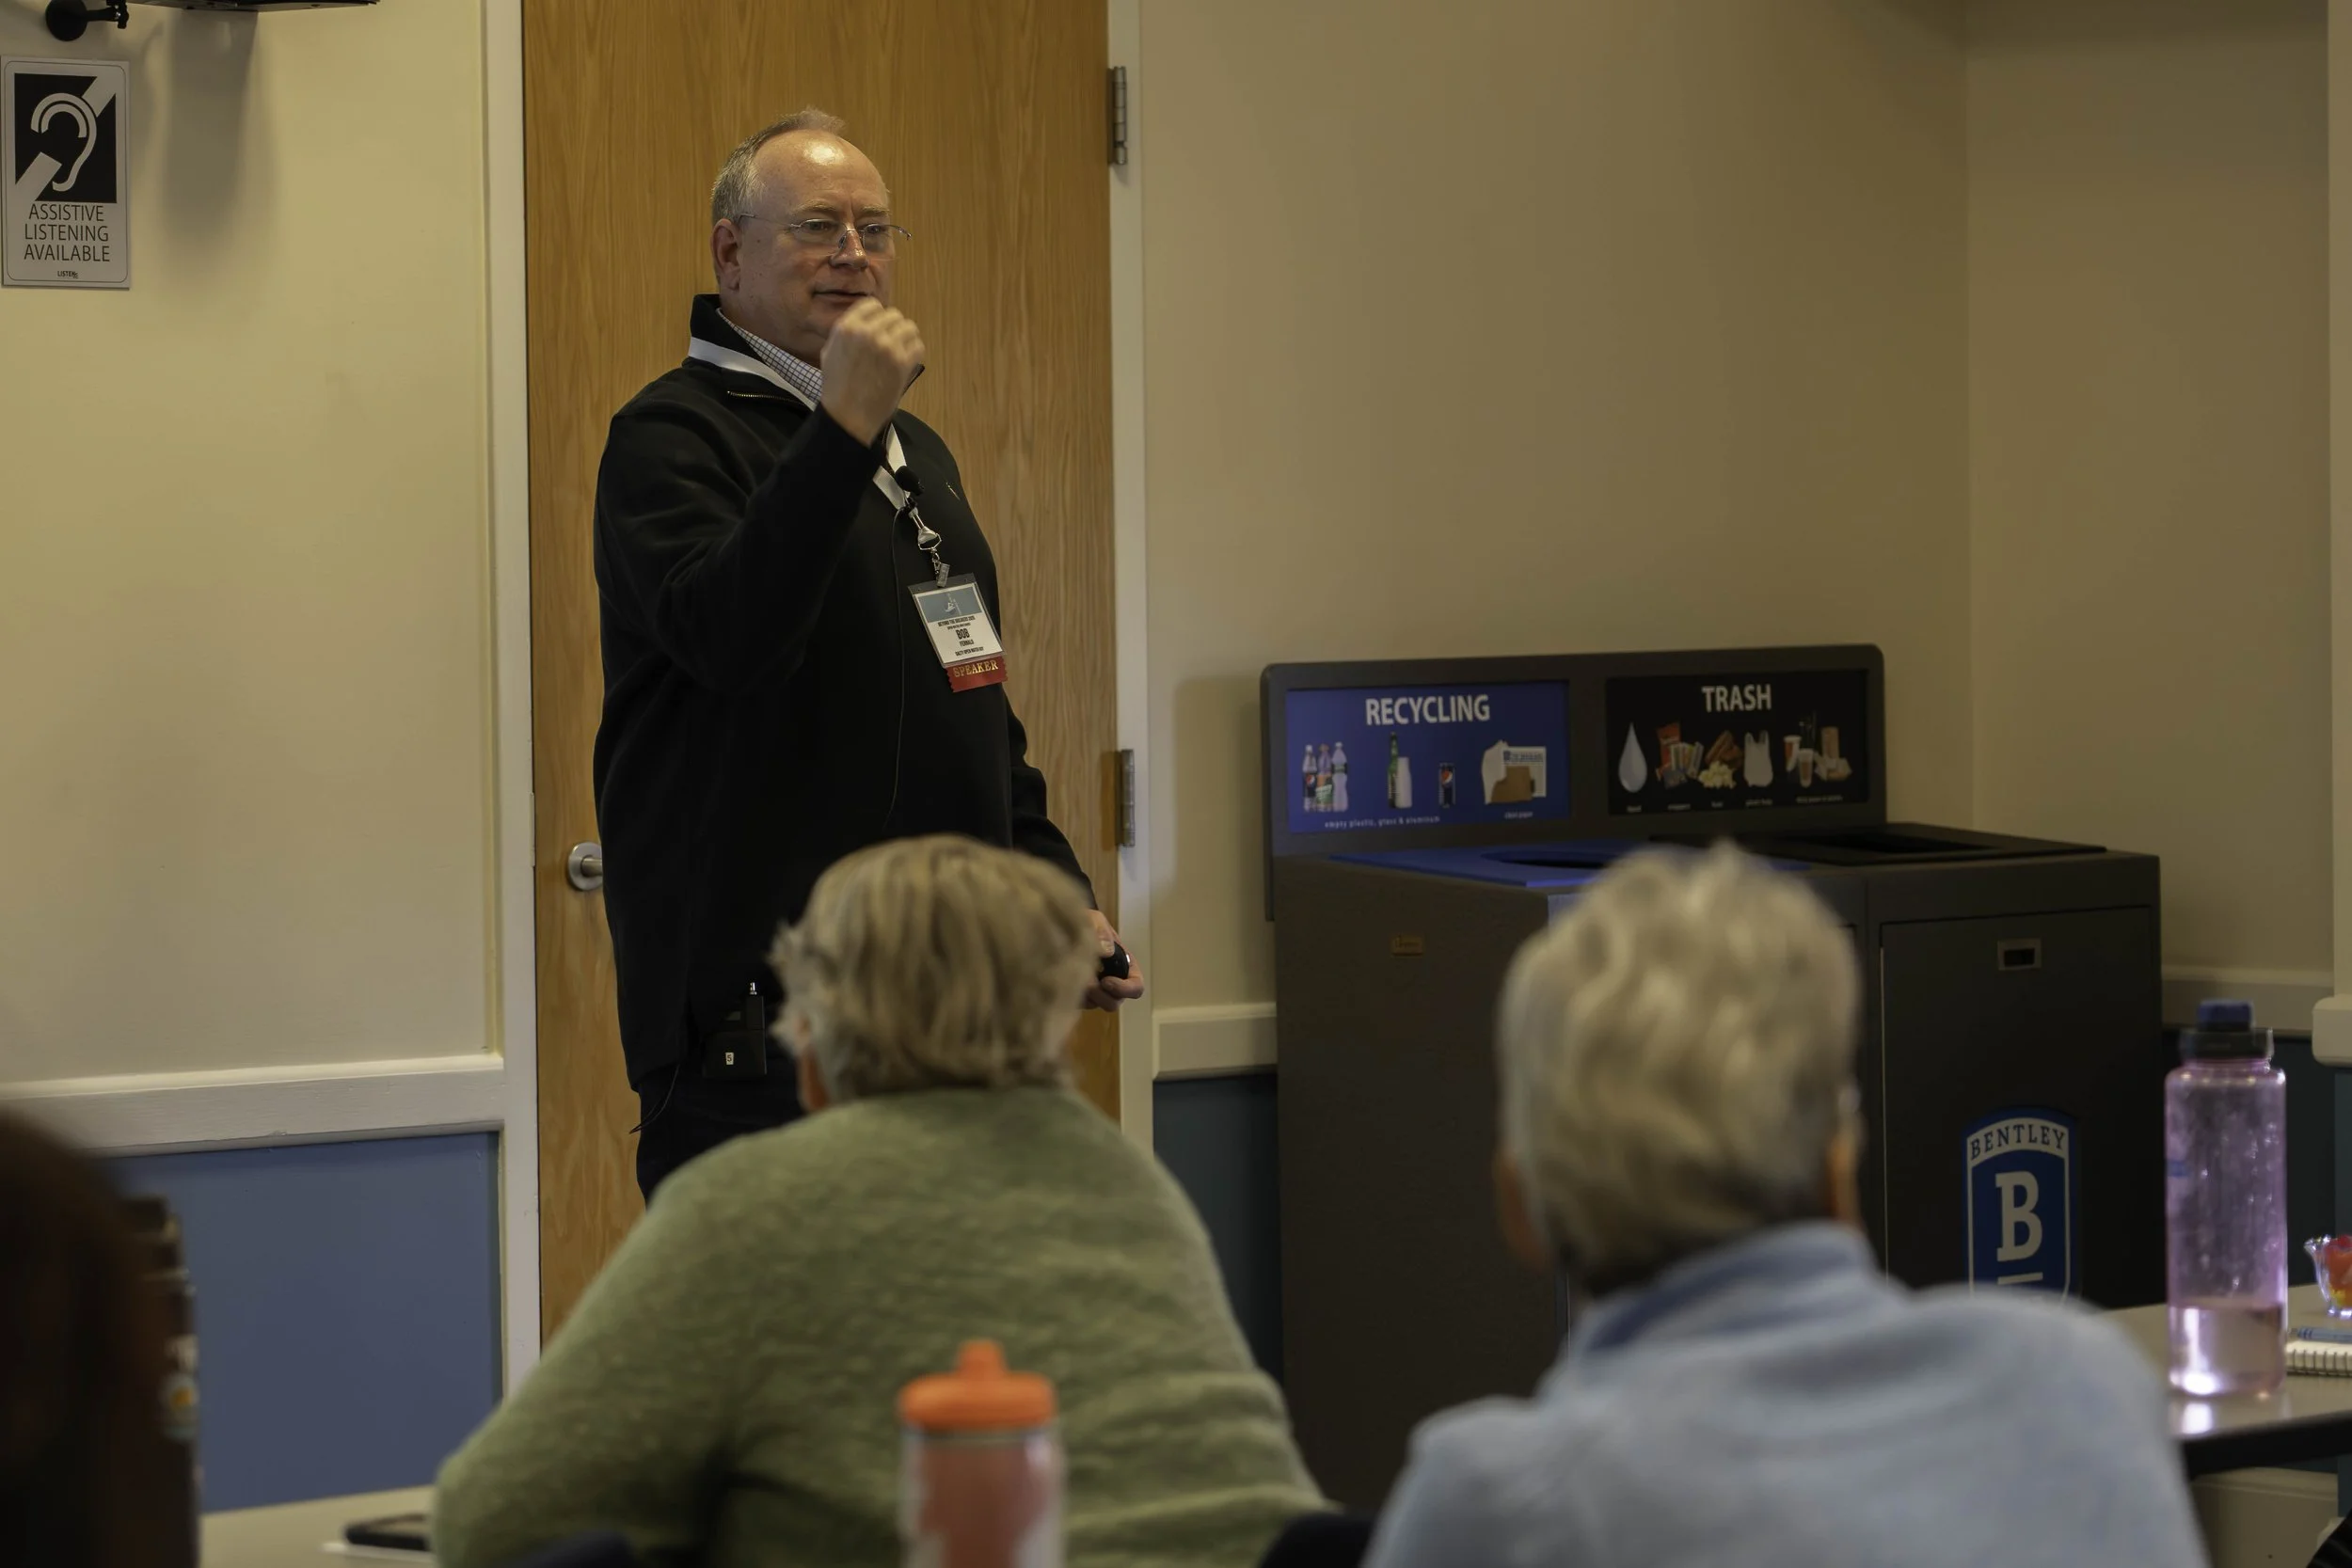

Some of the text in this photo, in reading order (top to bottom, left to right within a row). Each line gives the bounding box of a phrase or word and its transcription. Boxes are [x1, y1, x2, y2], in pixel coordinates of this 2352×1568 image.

[28, 203, 104, 222] ASSISTIVE
[24, 224, 109, 242] LISTENING
[24, 244, 110, 262] AVAILABLE
[956, 627, 970, 640] BOB
[952, 659, 998, 677] SPEAKER
[1701, 684, 1772, 712] TRASH
[1365, 694, 1490, 726] RECYCLING
[1970, 1124, 2066, 1161] BENTLEY
[1994, 1170, 2042, 1262] B
